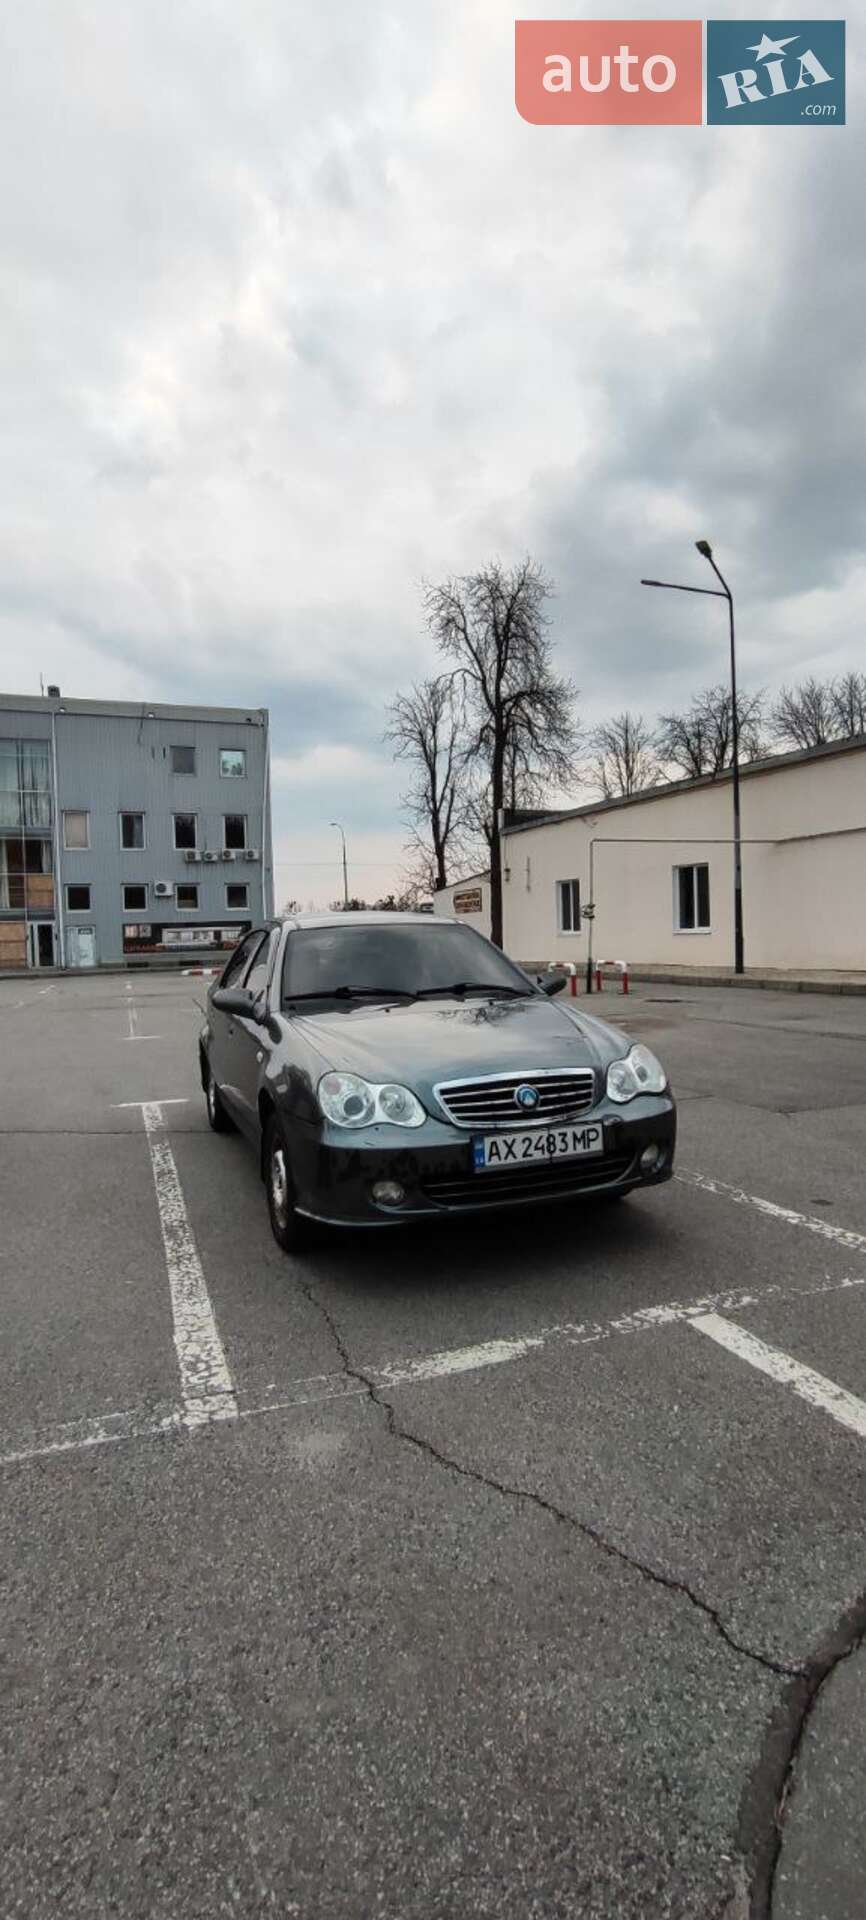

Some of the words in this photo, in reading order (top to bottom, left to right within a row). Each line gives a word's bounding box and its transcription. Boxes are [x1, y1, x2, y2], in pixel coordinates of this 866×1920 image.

[488, 1138, 517, 1162] AX
[522, 1133, 569, 1158] 2483
[572, 1128, 600, 1151] MP
